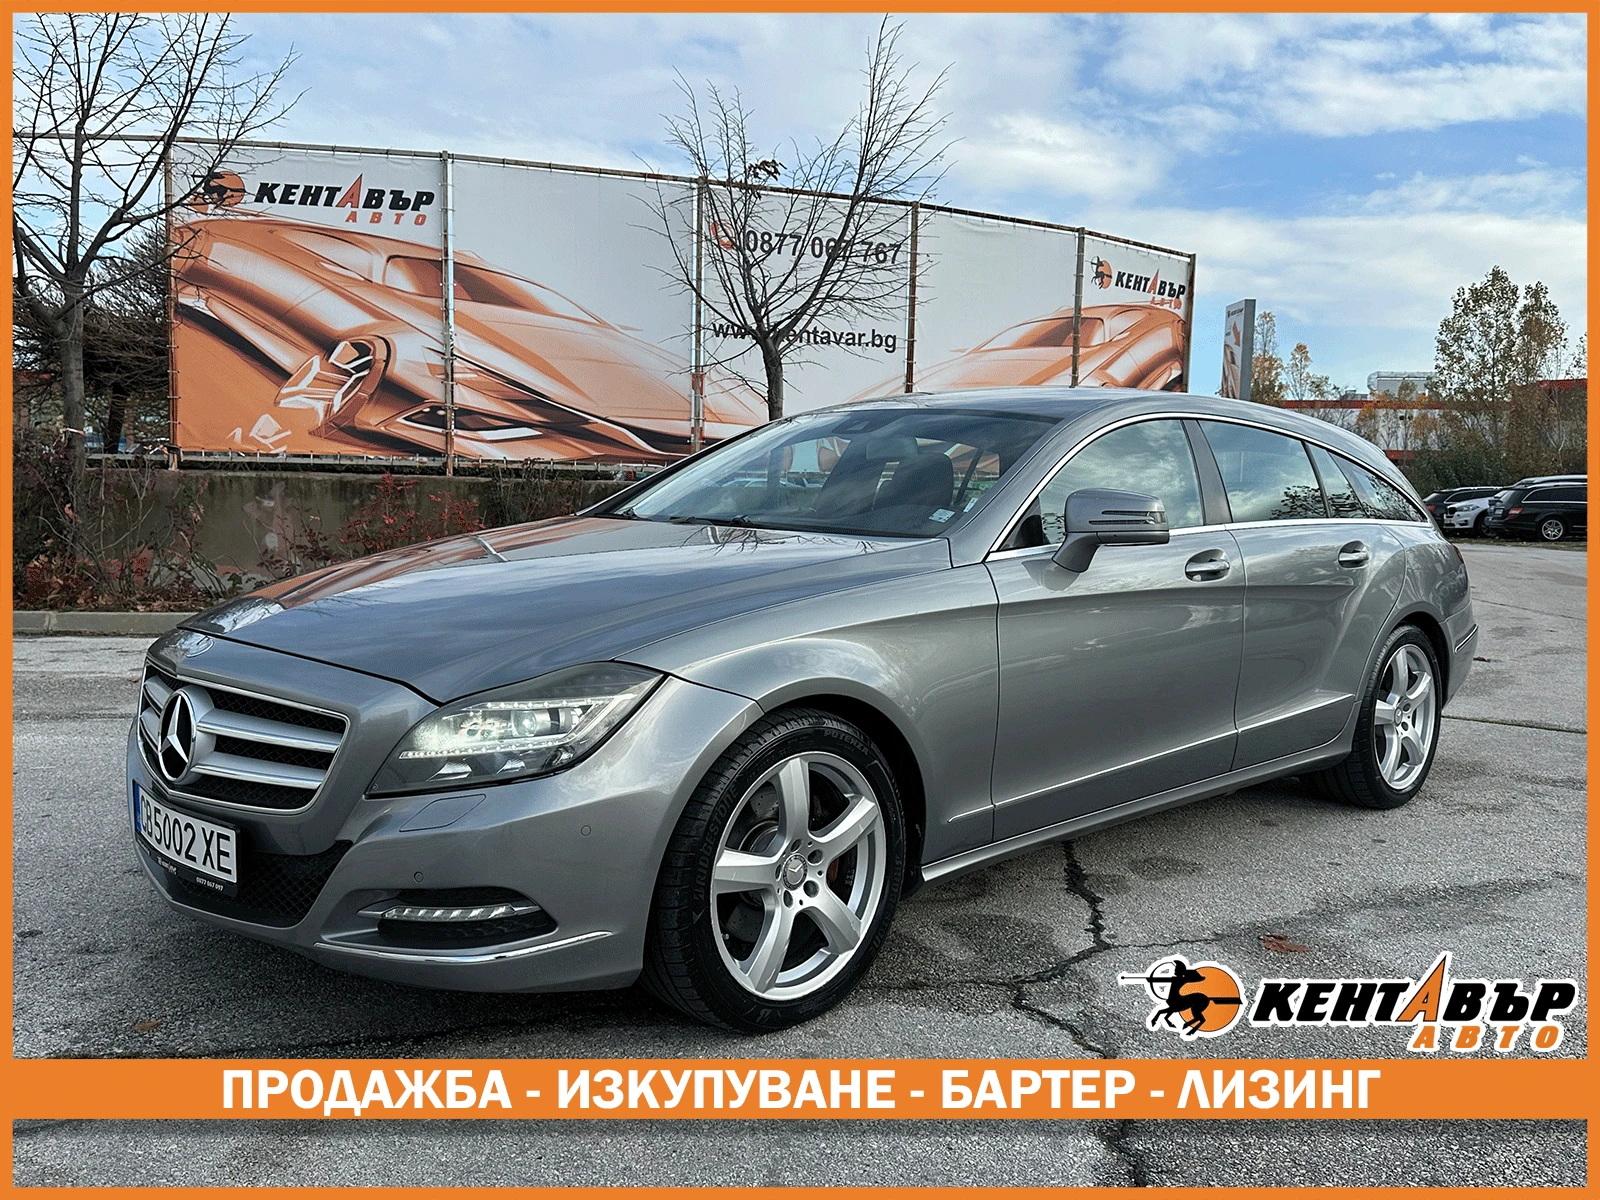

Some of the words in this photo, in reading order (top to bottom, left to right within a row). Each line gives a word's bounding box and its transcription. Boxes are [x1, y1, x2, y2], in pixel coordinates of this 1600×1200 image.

[254, 174, 435, 212] КЕНТАВЪР
[345, 210, 428, 226] АВТО
[746, 230, 802, 256] 0877
[861, 241, 902, 264] 767
[1115, 268, 1186, 299] КЕНТАВЪР
[712, 322, 898, 353] wwentavar.bg
[823, 729, 872, 757] POTENZA
